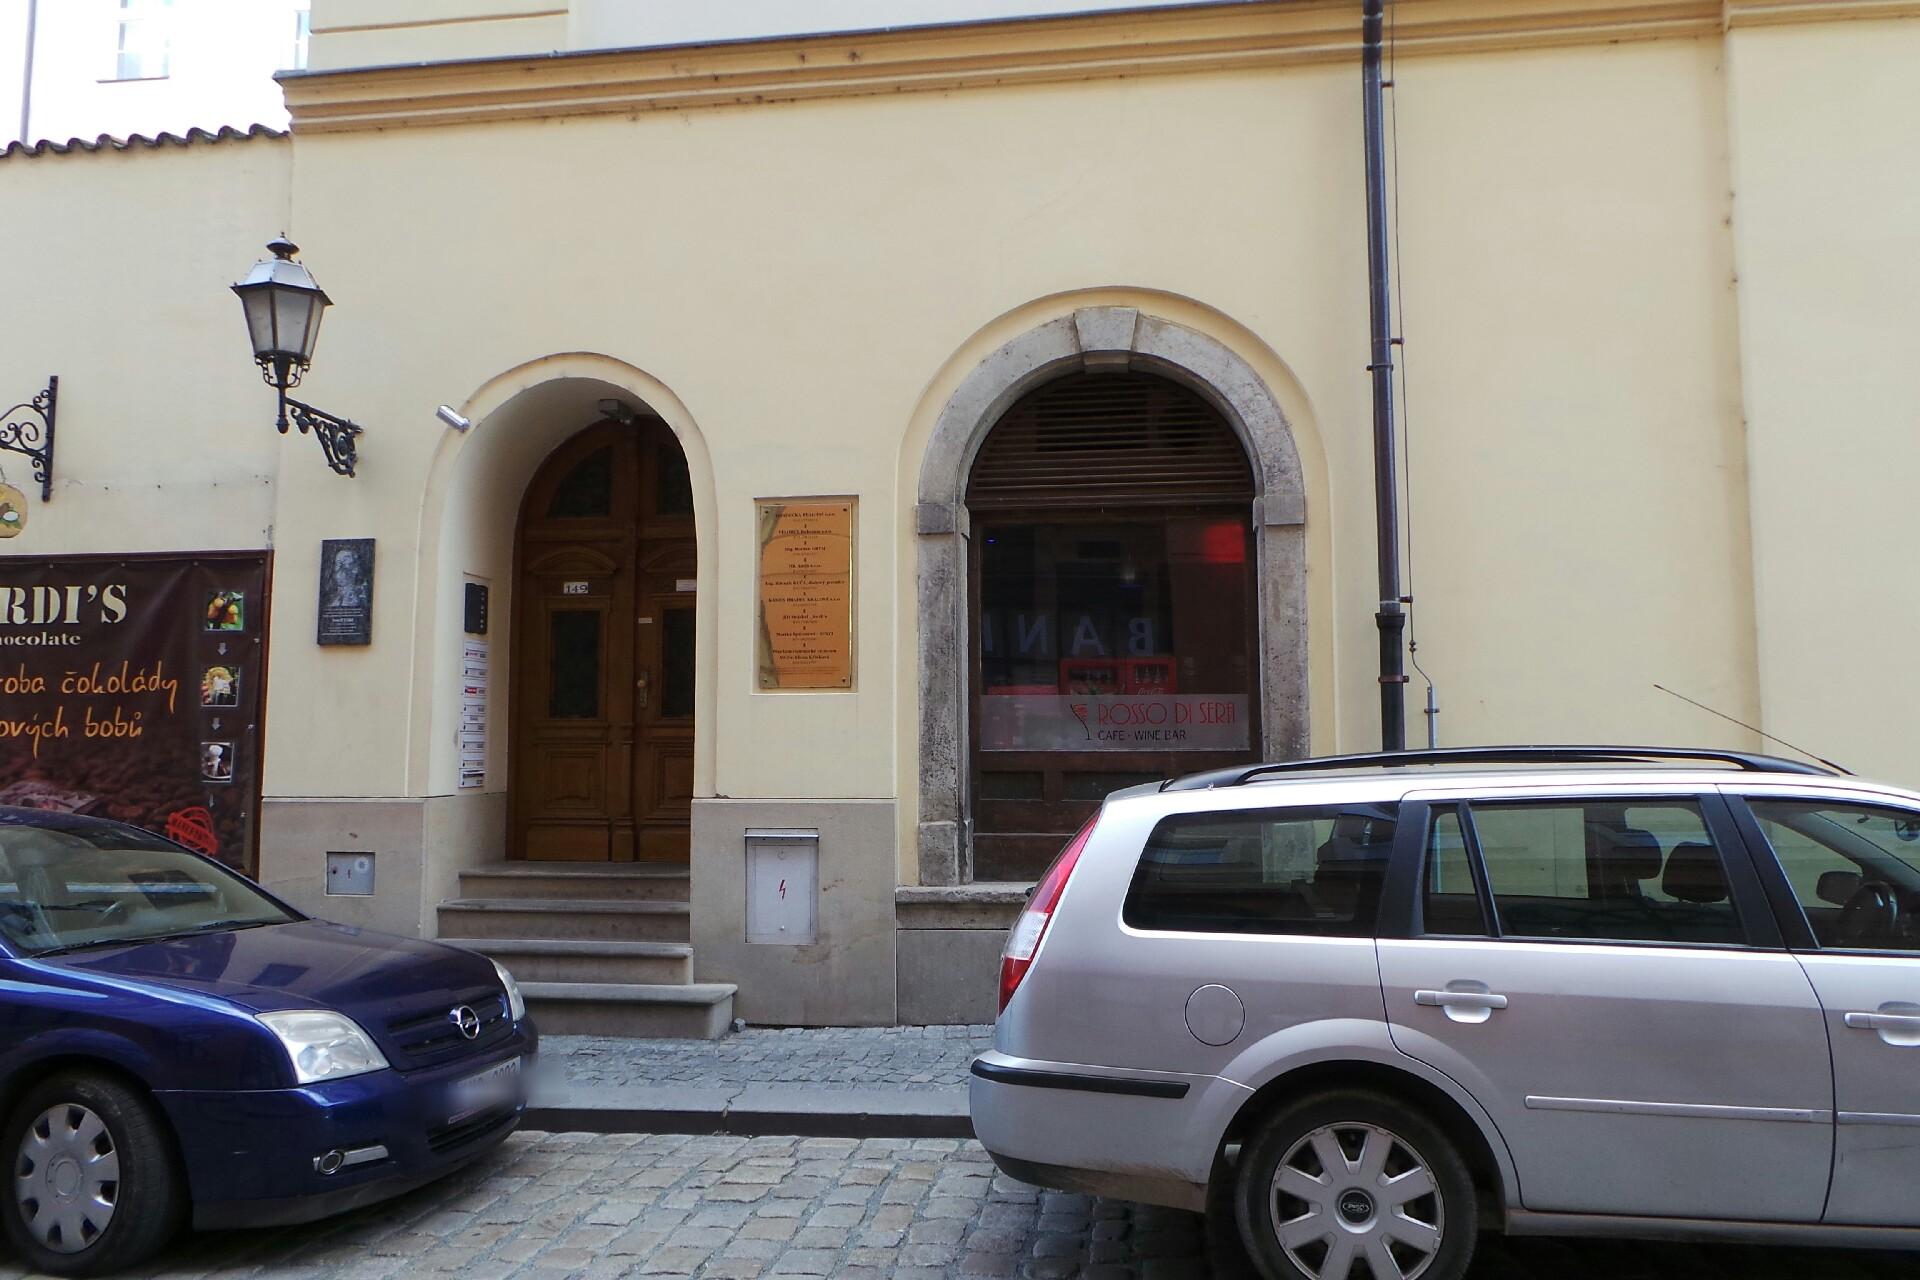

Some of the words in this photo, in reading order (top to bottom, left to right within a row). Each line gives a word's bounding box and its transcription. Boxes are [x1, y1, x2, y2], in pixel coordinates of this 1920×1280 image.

[566, 584, 588, 594] 149
[0, 631, 81, 646] ocolate
[61, 660, 178, 714] čokolády
[85, 706, 144, 737] bobů
[1097, 702, 1168, 725] ROSSO
[1175, 702, 1192, 724] DI
[1199, 702, 1236, 724] SERA
[1098, 730, 1125, 741] CAFE
[1134, 730, 1162, 741] WINE
[1164, 729, 1187, 741] BAR
